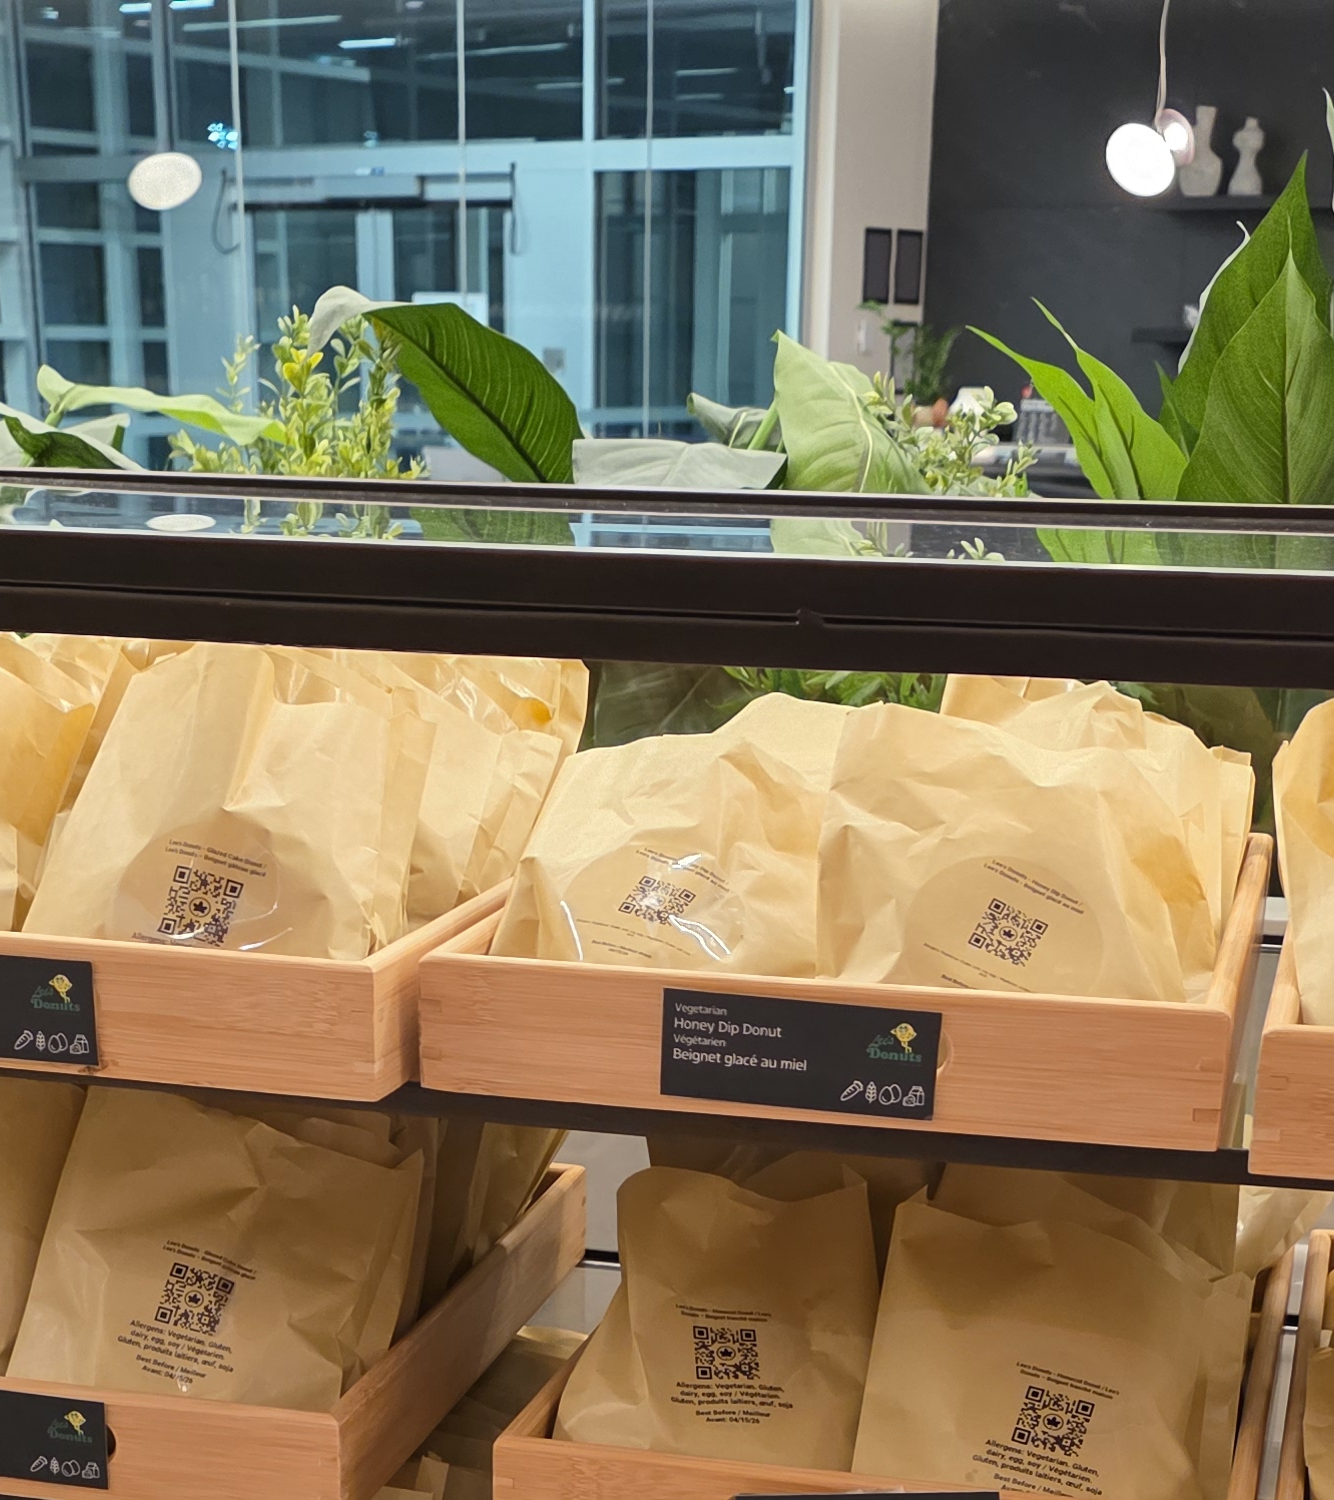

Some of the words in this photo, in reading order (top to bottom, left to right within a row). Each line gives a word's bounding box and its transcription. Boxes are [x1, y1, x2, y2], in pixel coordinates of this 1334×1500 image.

[30, 998, 81, 1012] Donuts
[675, 1003, 727, 1015] Vegetarian
[674, 1017, 715, 1034] Honey
[718, 1021, 739, 1036] Dip
[742, 1023, 782, 1038] Donut
[673, 1033, 726, 1047] Végétarien
[673, 1048, 721, 1064] Beignet
[724, 1053, 758, 1067] glacé
[760, 1058, 777, 1068] au
[780, 1058, 807, 1071] miel
[866, 1047, 922, 1063] Donuts
[47, 1430, 93, 1444] Donuts
